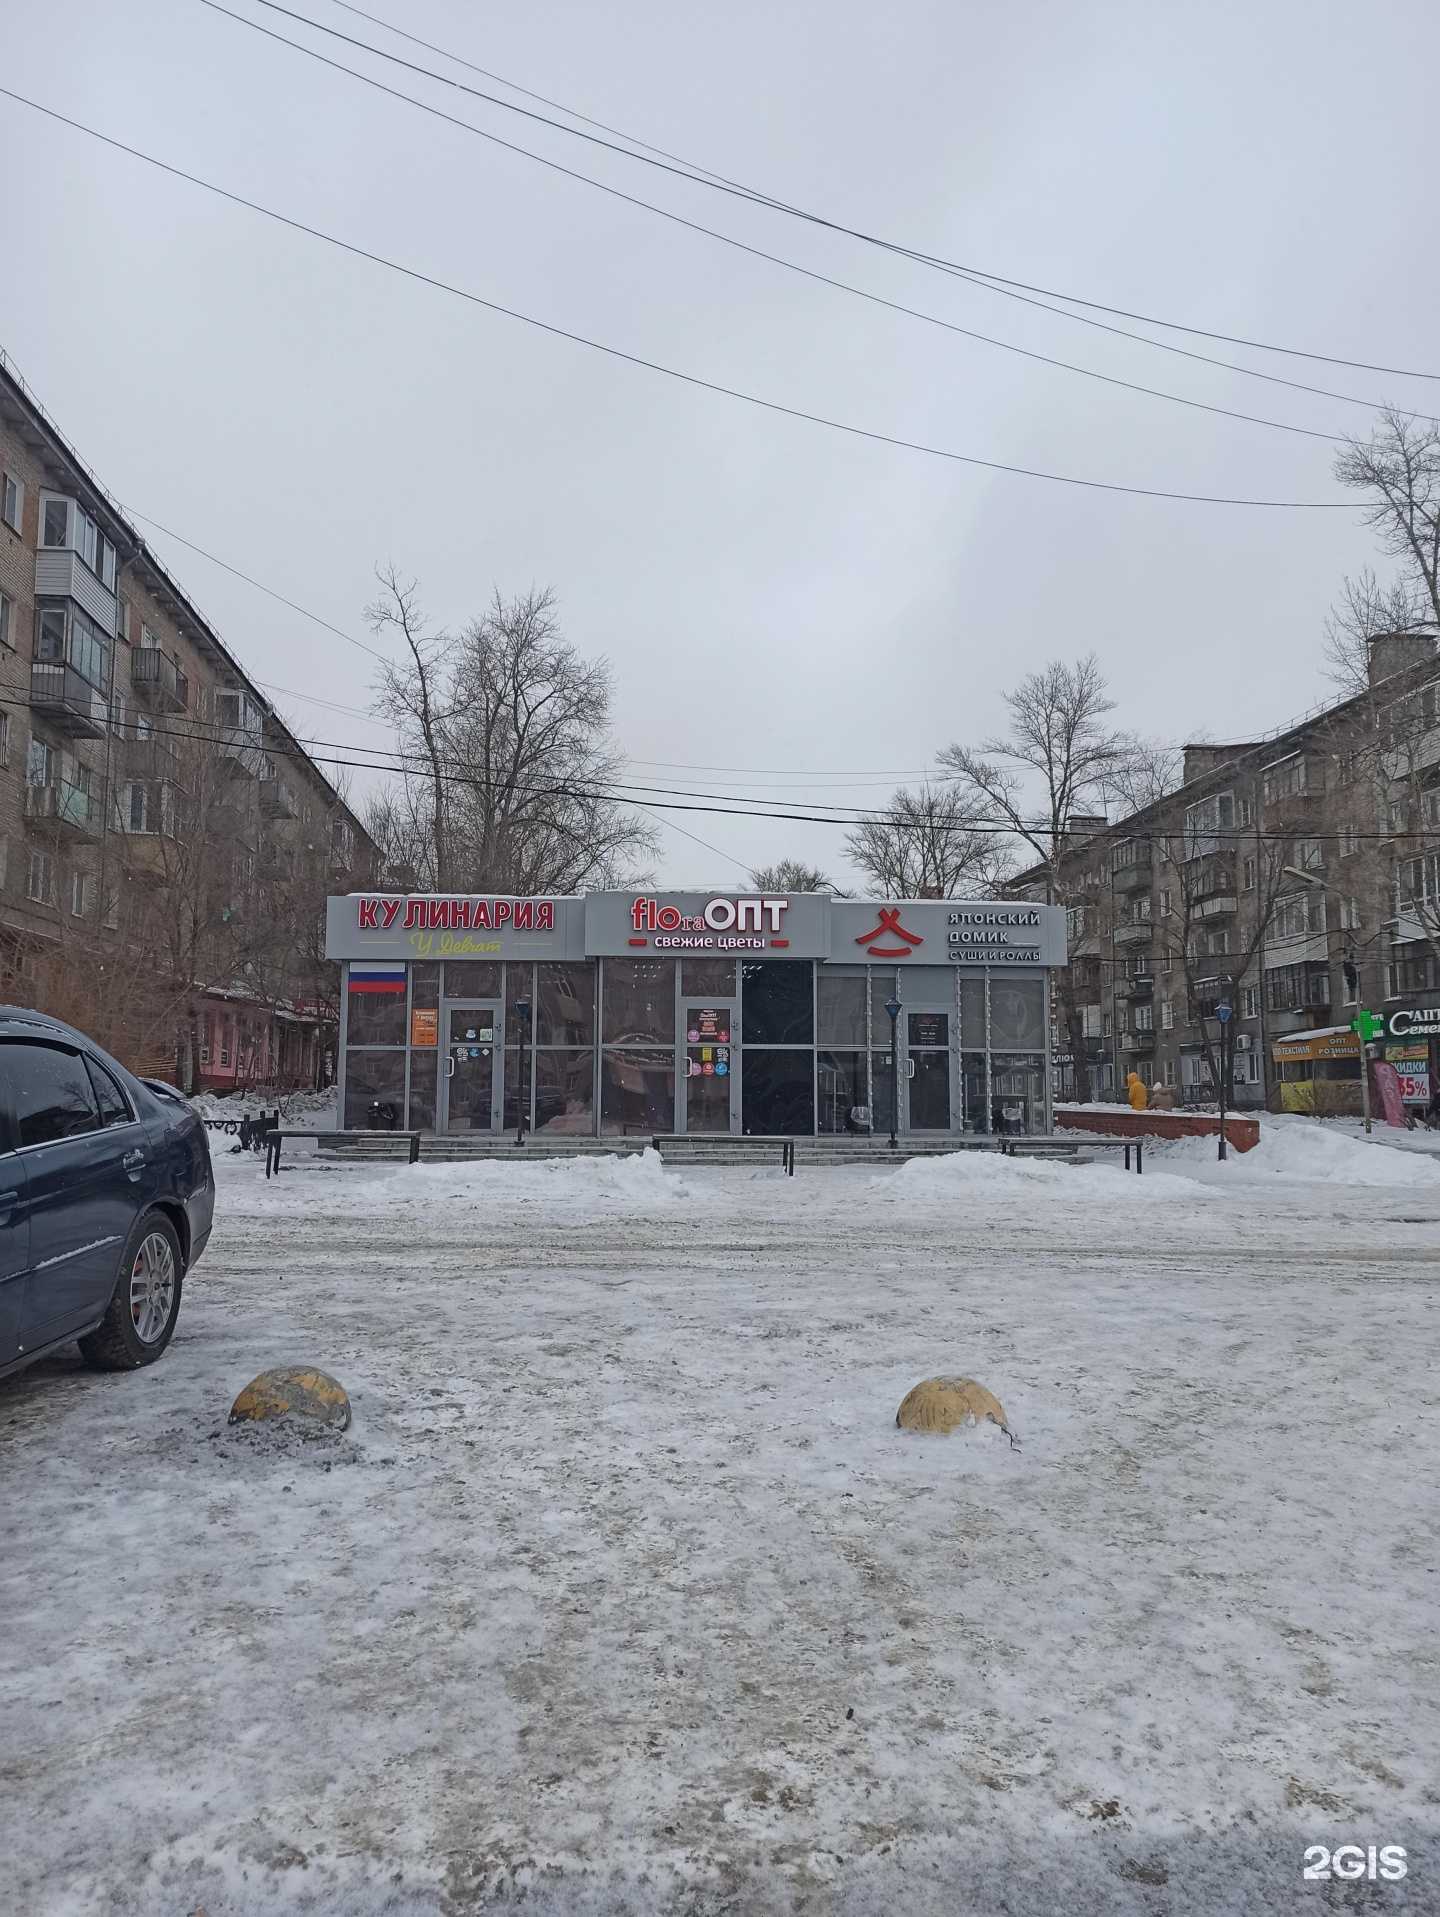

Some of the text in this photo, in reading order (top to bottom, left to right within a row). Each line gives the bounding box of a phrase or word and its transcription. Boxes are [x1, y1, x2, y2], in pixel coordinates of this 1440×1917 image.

[359, 898, 554, 929] КУЛИНАРИЯ
[949, 910, 1041, 926] ЯПОНСКИЙ
[949, 931, 1009, 943] ДОМИК
[654, 937, 765, 952] свежие цветы
[949, 951, 1041, 961] СУШИ И РОЛЛЫ
[1394, 1061, 1426, 1073] КИДКИ
